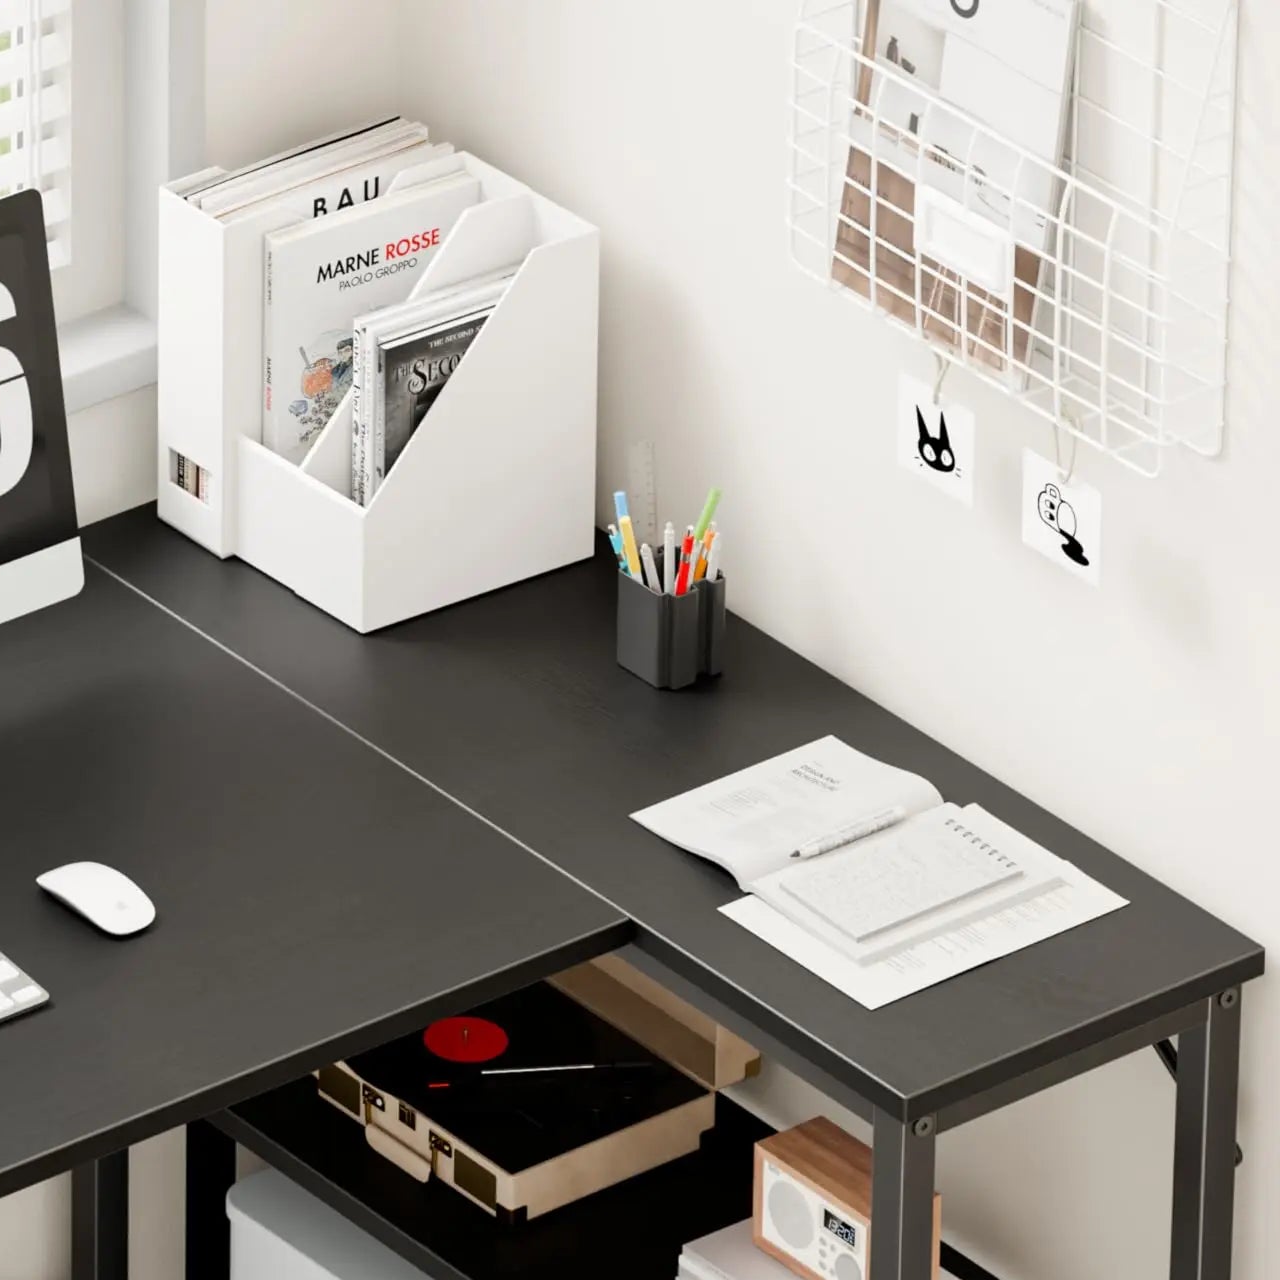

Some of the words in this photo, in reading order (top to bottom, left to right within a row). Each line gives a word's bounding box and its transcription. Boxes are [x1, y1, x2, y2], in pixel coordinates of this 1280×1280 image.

[316, 247, 380, 284] MARNE
[385, 227, 441, 261] ROSSE
[338, 271, 374, 292] PAOLO
[375, 257, 419, 280] GROPPO
[407, 351, 466, 396] SECO
